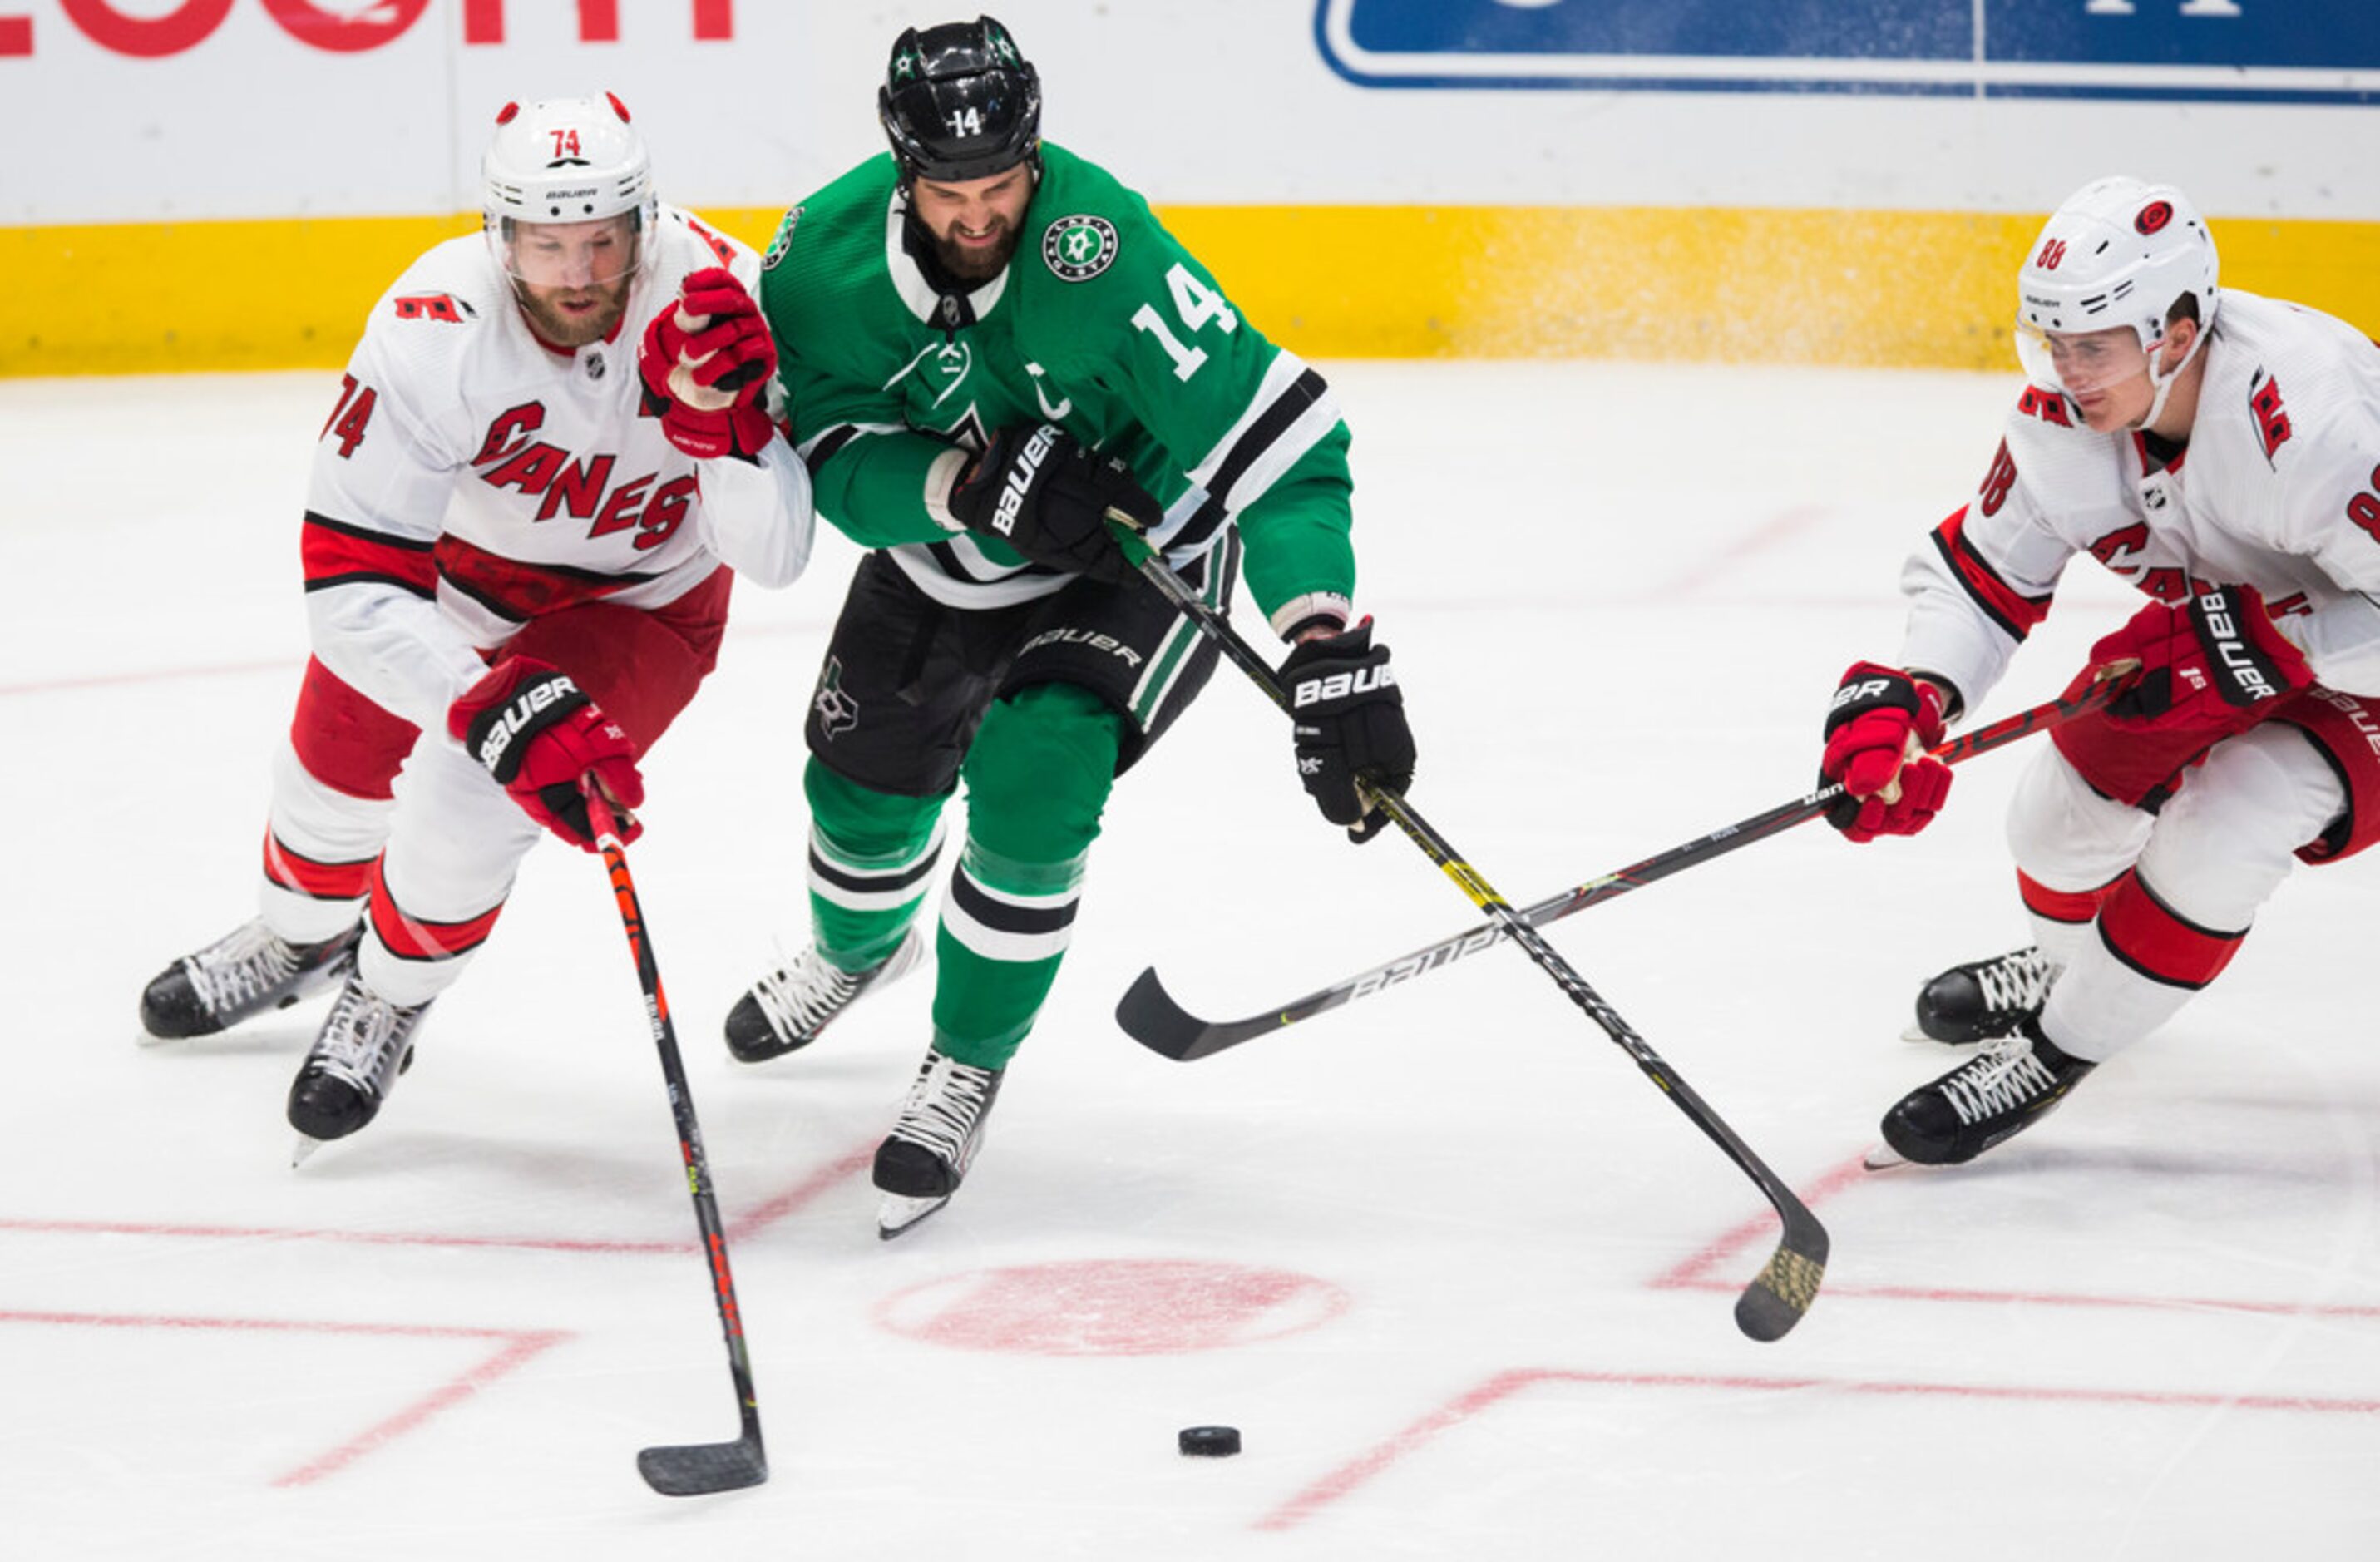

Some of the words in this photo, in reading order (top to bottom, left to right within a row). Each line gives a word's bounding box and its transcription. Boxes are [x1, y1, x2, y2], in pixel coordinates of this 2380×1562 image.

[549, 128, 581, 158] 74
[953, 107, 981, 137] 14
[2037, 238, 2067, 270] 88
[1130, 261, 1237, 383] 14
[318, 371, 378, 461] 74
[470, 399, 699, 551] CANES
[991, 423, 1064, 537] BAUER
[2347, 462, 2380, 546] 8
[1294, 664, 1398, 708] BAUE
[2200, 591, 2277, 700] BAUER
[480, 675, 579, 773] BAUER
[2308, 687, 2380, 764] BAUE
